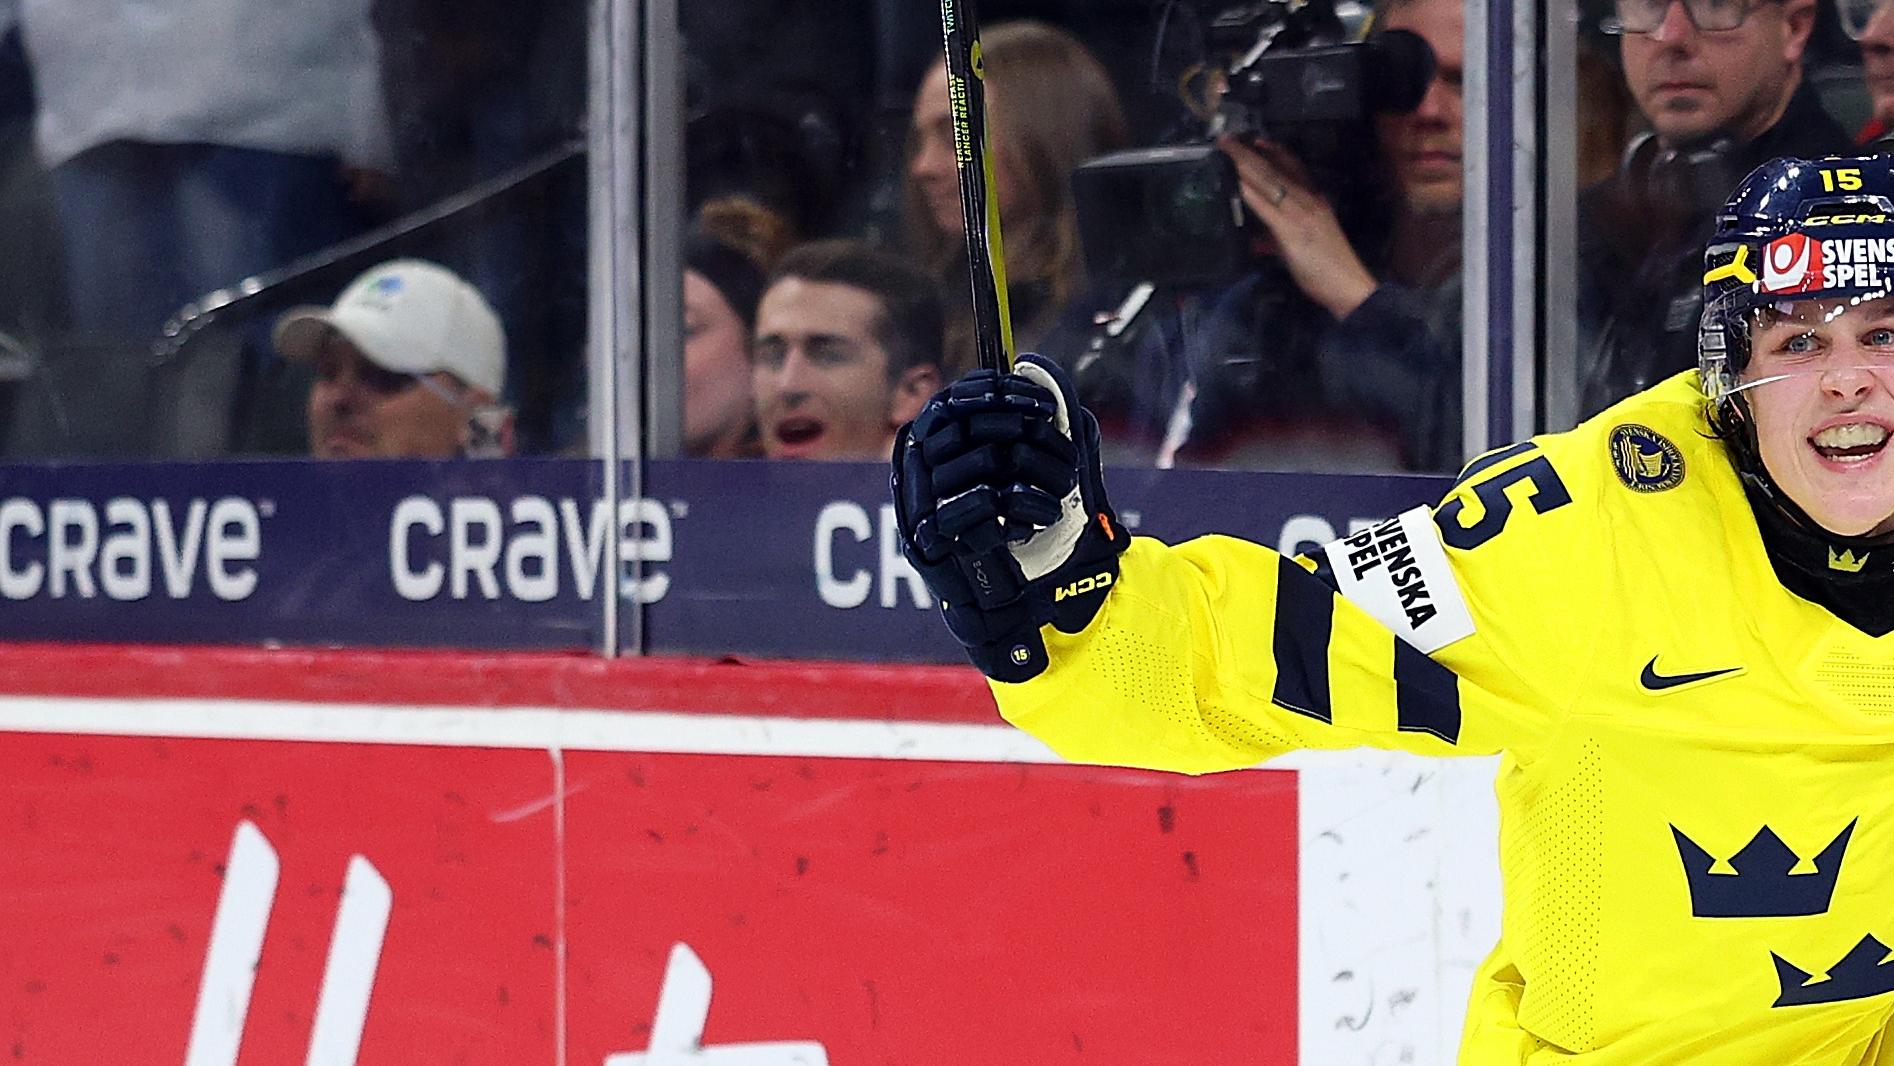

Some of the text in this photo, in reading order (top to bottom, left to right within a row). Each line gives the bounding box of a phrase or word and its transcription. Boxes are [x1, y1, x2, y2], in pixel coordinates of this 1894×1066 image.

[945, 0, 956, 35] TWITC
[956, 77, 973, 162] LANCER REACTIF
[1819, 168, 1864, 192] 15
[1804, 214, 1887, 226] CCM
[1823, 263, 1882, 288] SPEL
[1343, 526, 1382, 583] PEL
[1055, 571, 1112, 602] CCM
[1372, 514, 1438, 631] VENSKA
[1013, 648, 1029, 661] 15
